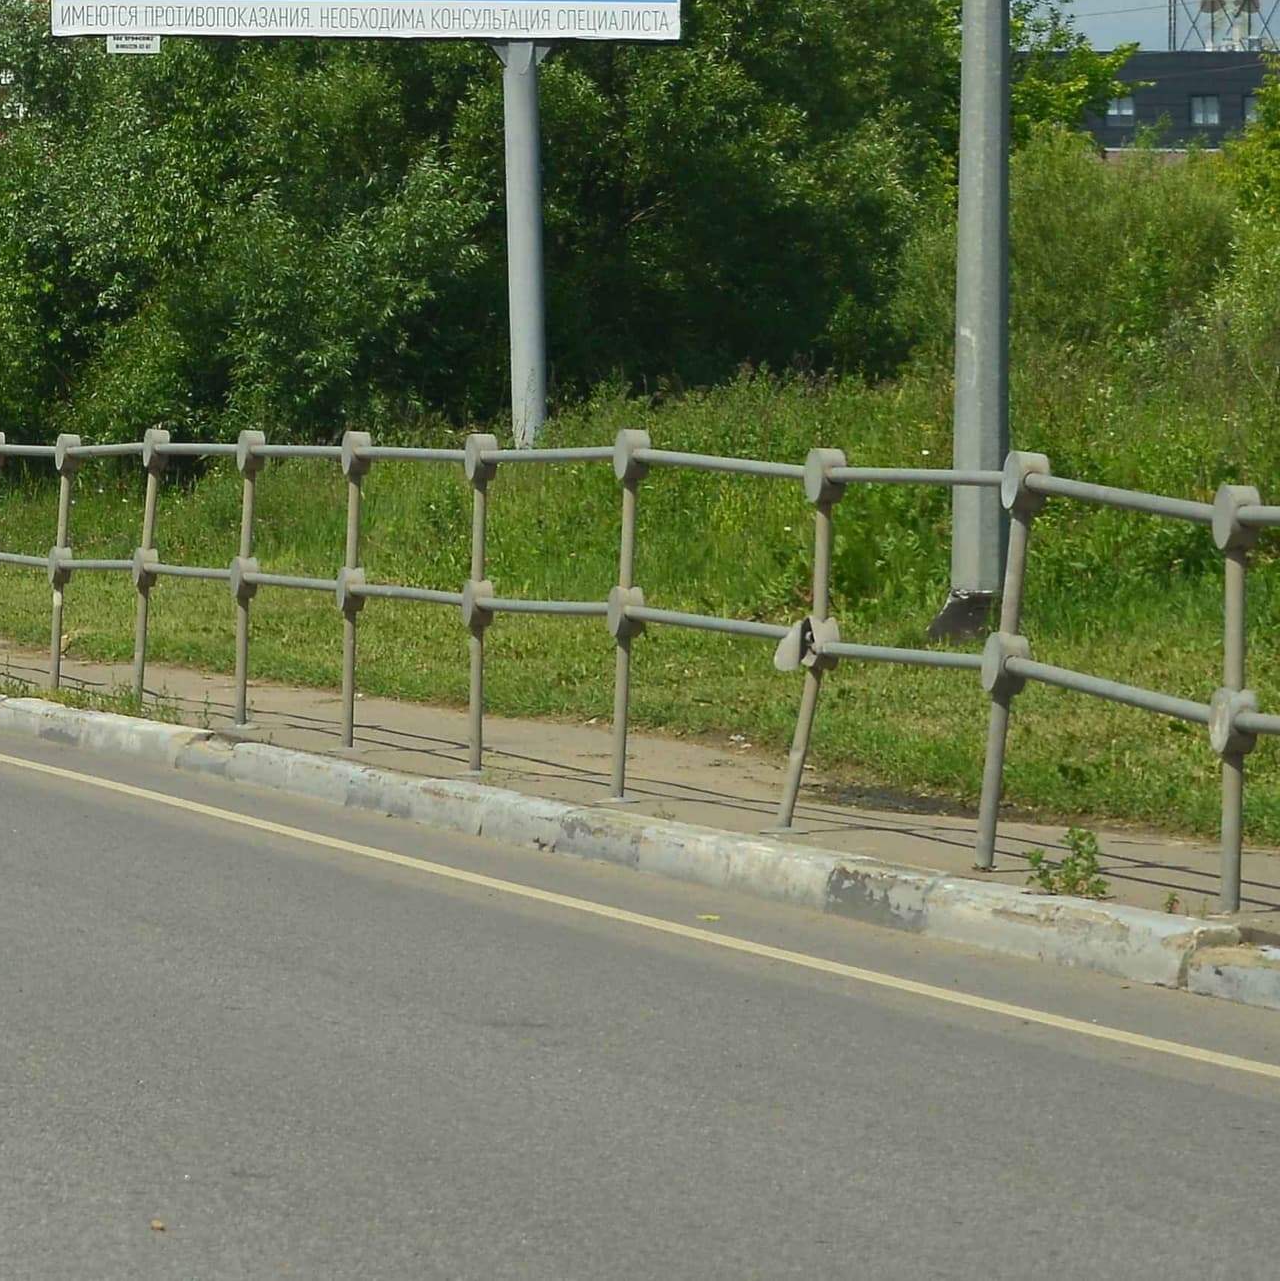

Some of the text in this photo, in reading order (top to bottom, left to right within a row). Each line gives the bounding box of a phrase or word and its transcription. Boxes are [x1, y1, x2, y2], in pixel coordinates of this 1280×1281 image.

[60, 5, 669, 34] ИМЕЮТСЯ ПРОТИВОПОКАЗАНИЯ. НЕОБХОДИМА КОНСУЛЬТАЦИЯ СПЕЦИАЛИСТА
